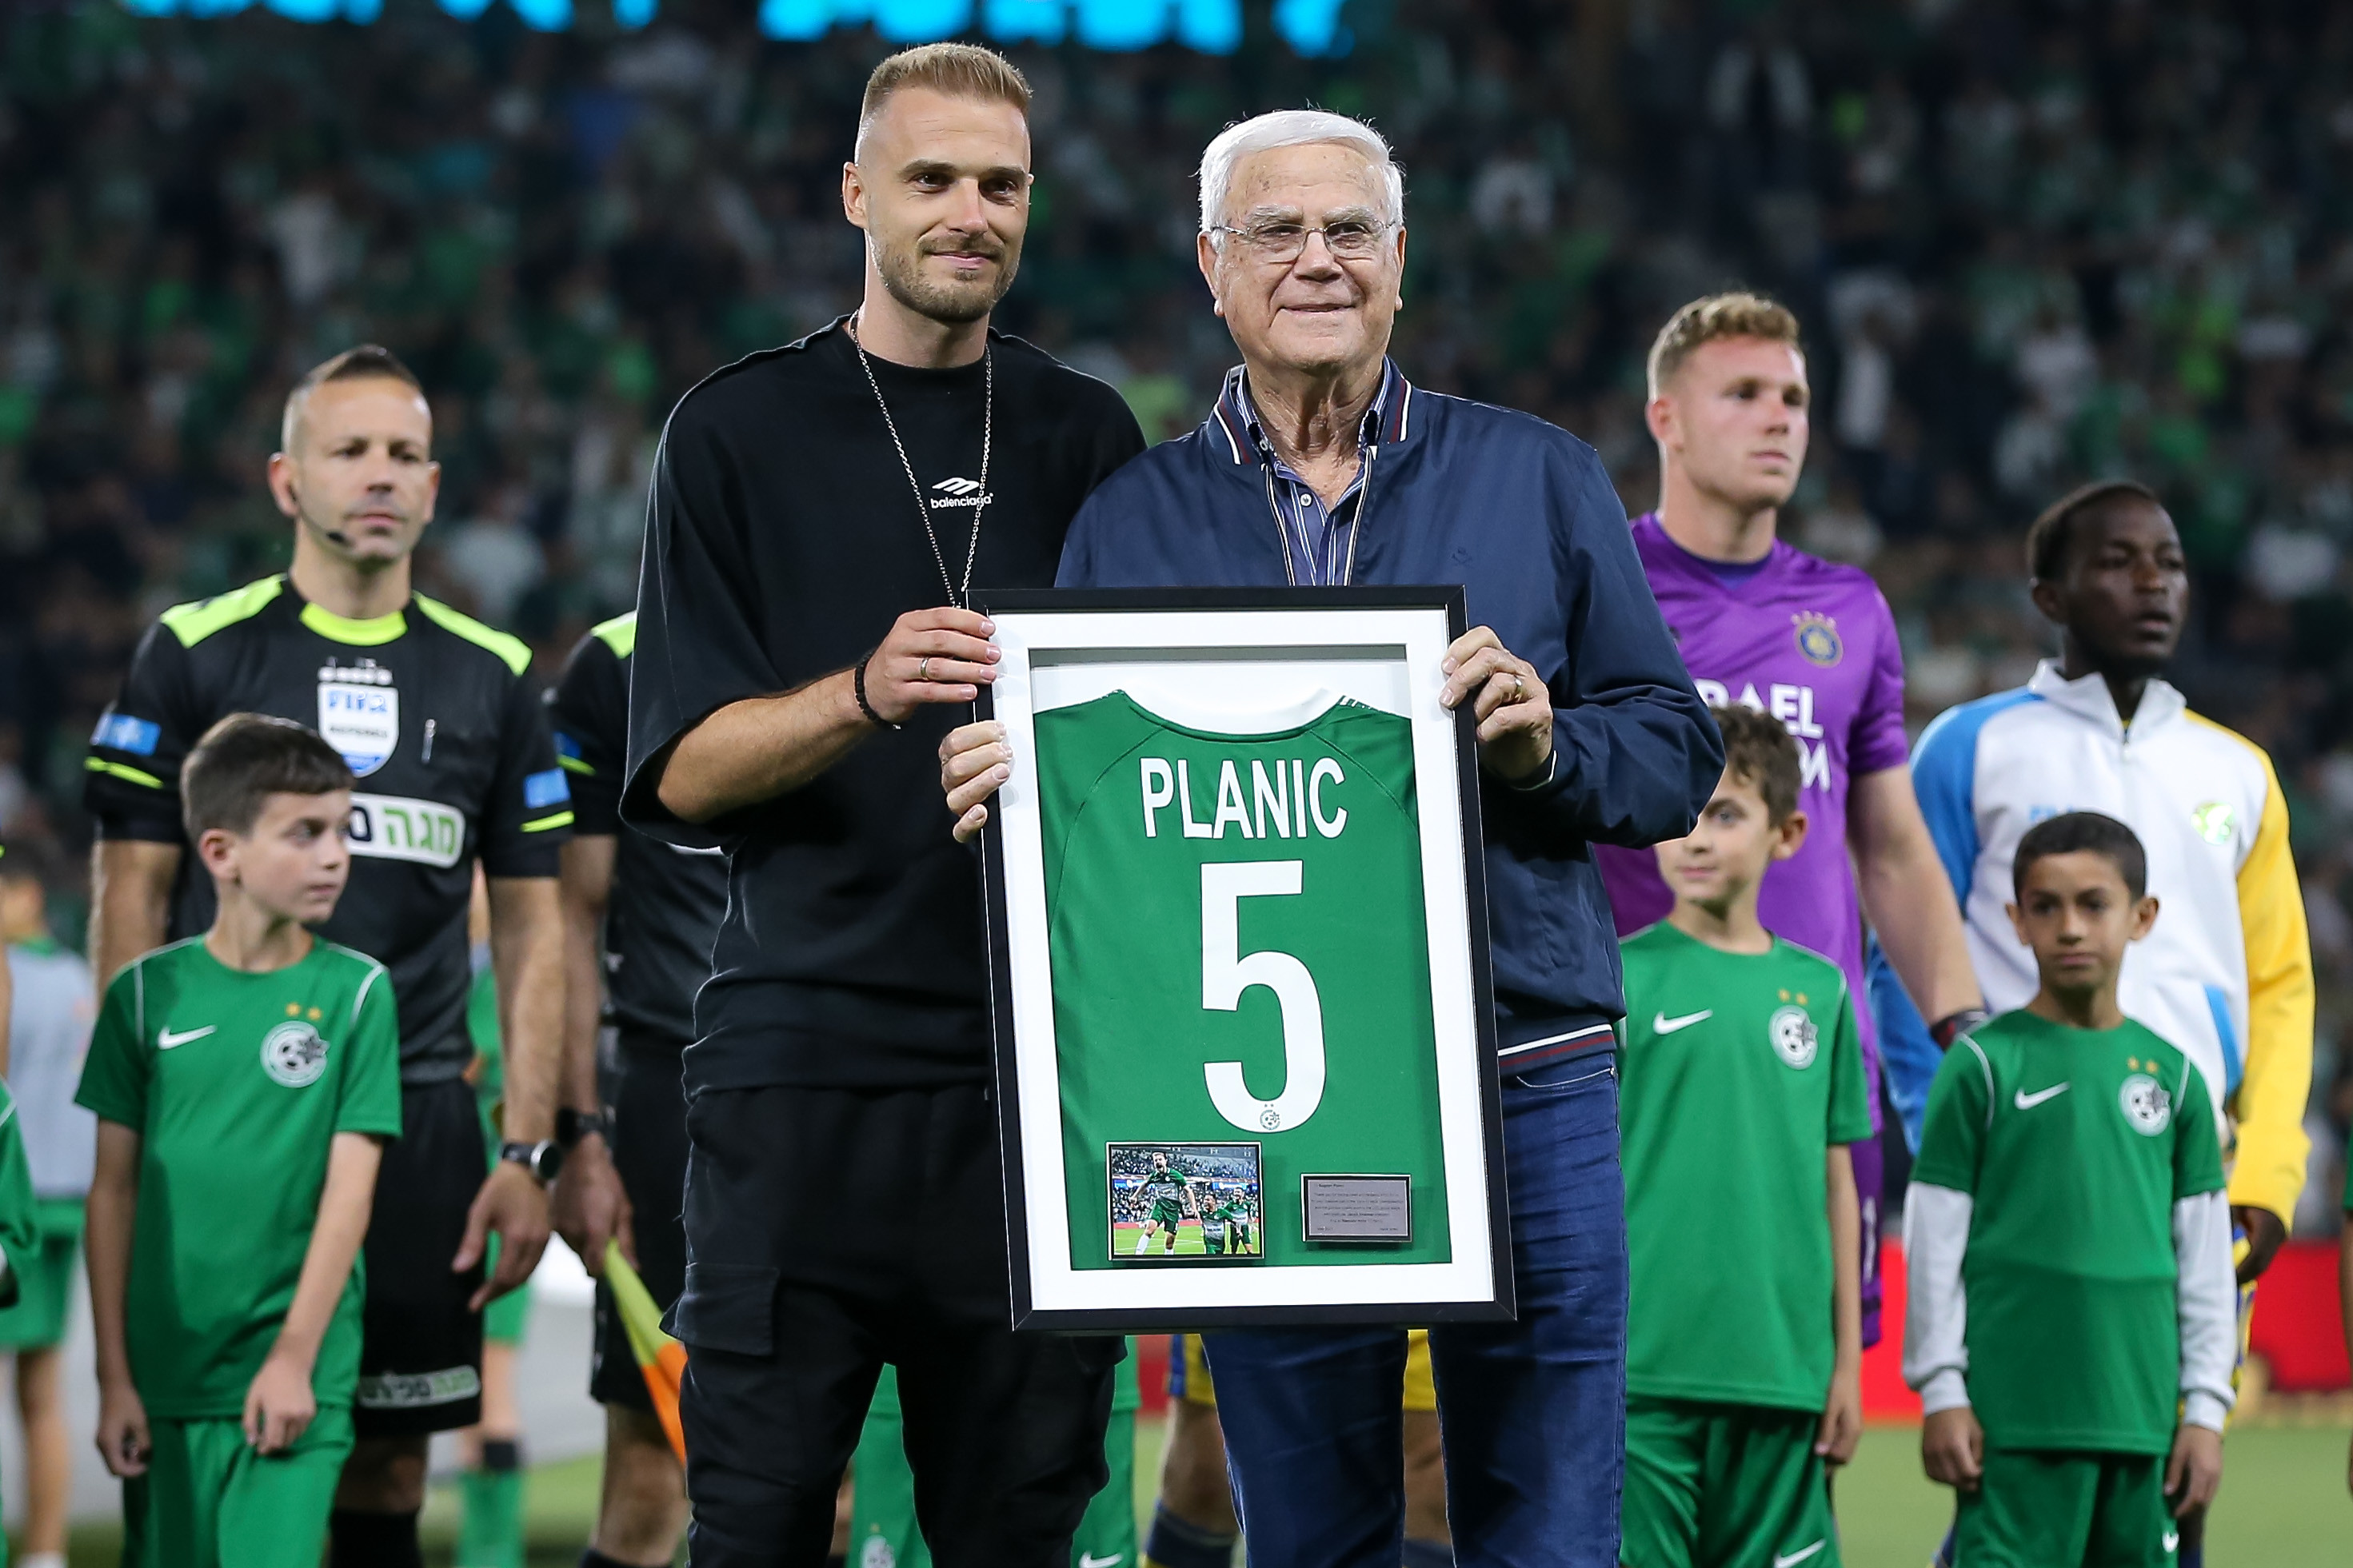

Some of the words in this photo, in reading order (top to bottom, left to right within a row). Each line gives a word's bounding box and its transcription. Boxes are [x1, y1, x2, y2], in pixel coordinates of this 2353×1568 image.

[930, 495, 992, 509] balenciaga
[1693, 677, 1825, 737] RAEL
[1139, 756, 1348, 840] PLANIC
[1200, 860, 1327, 1134] 5
